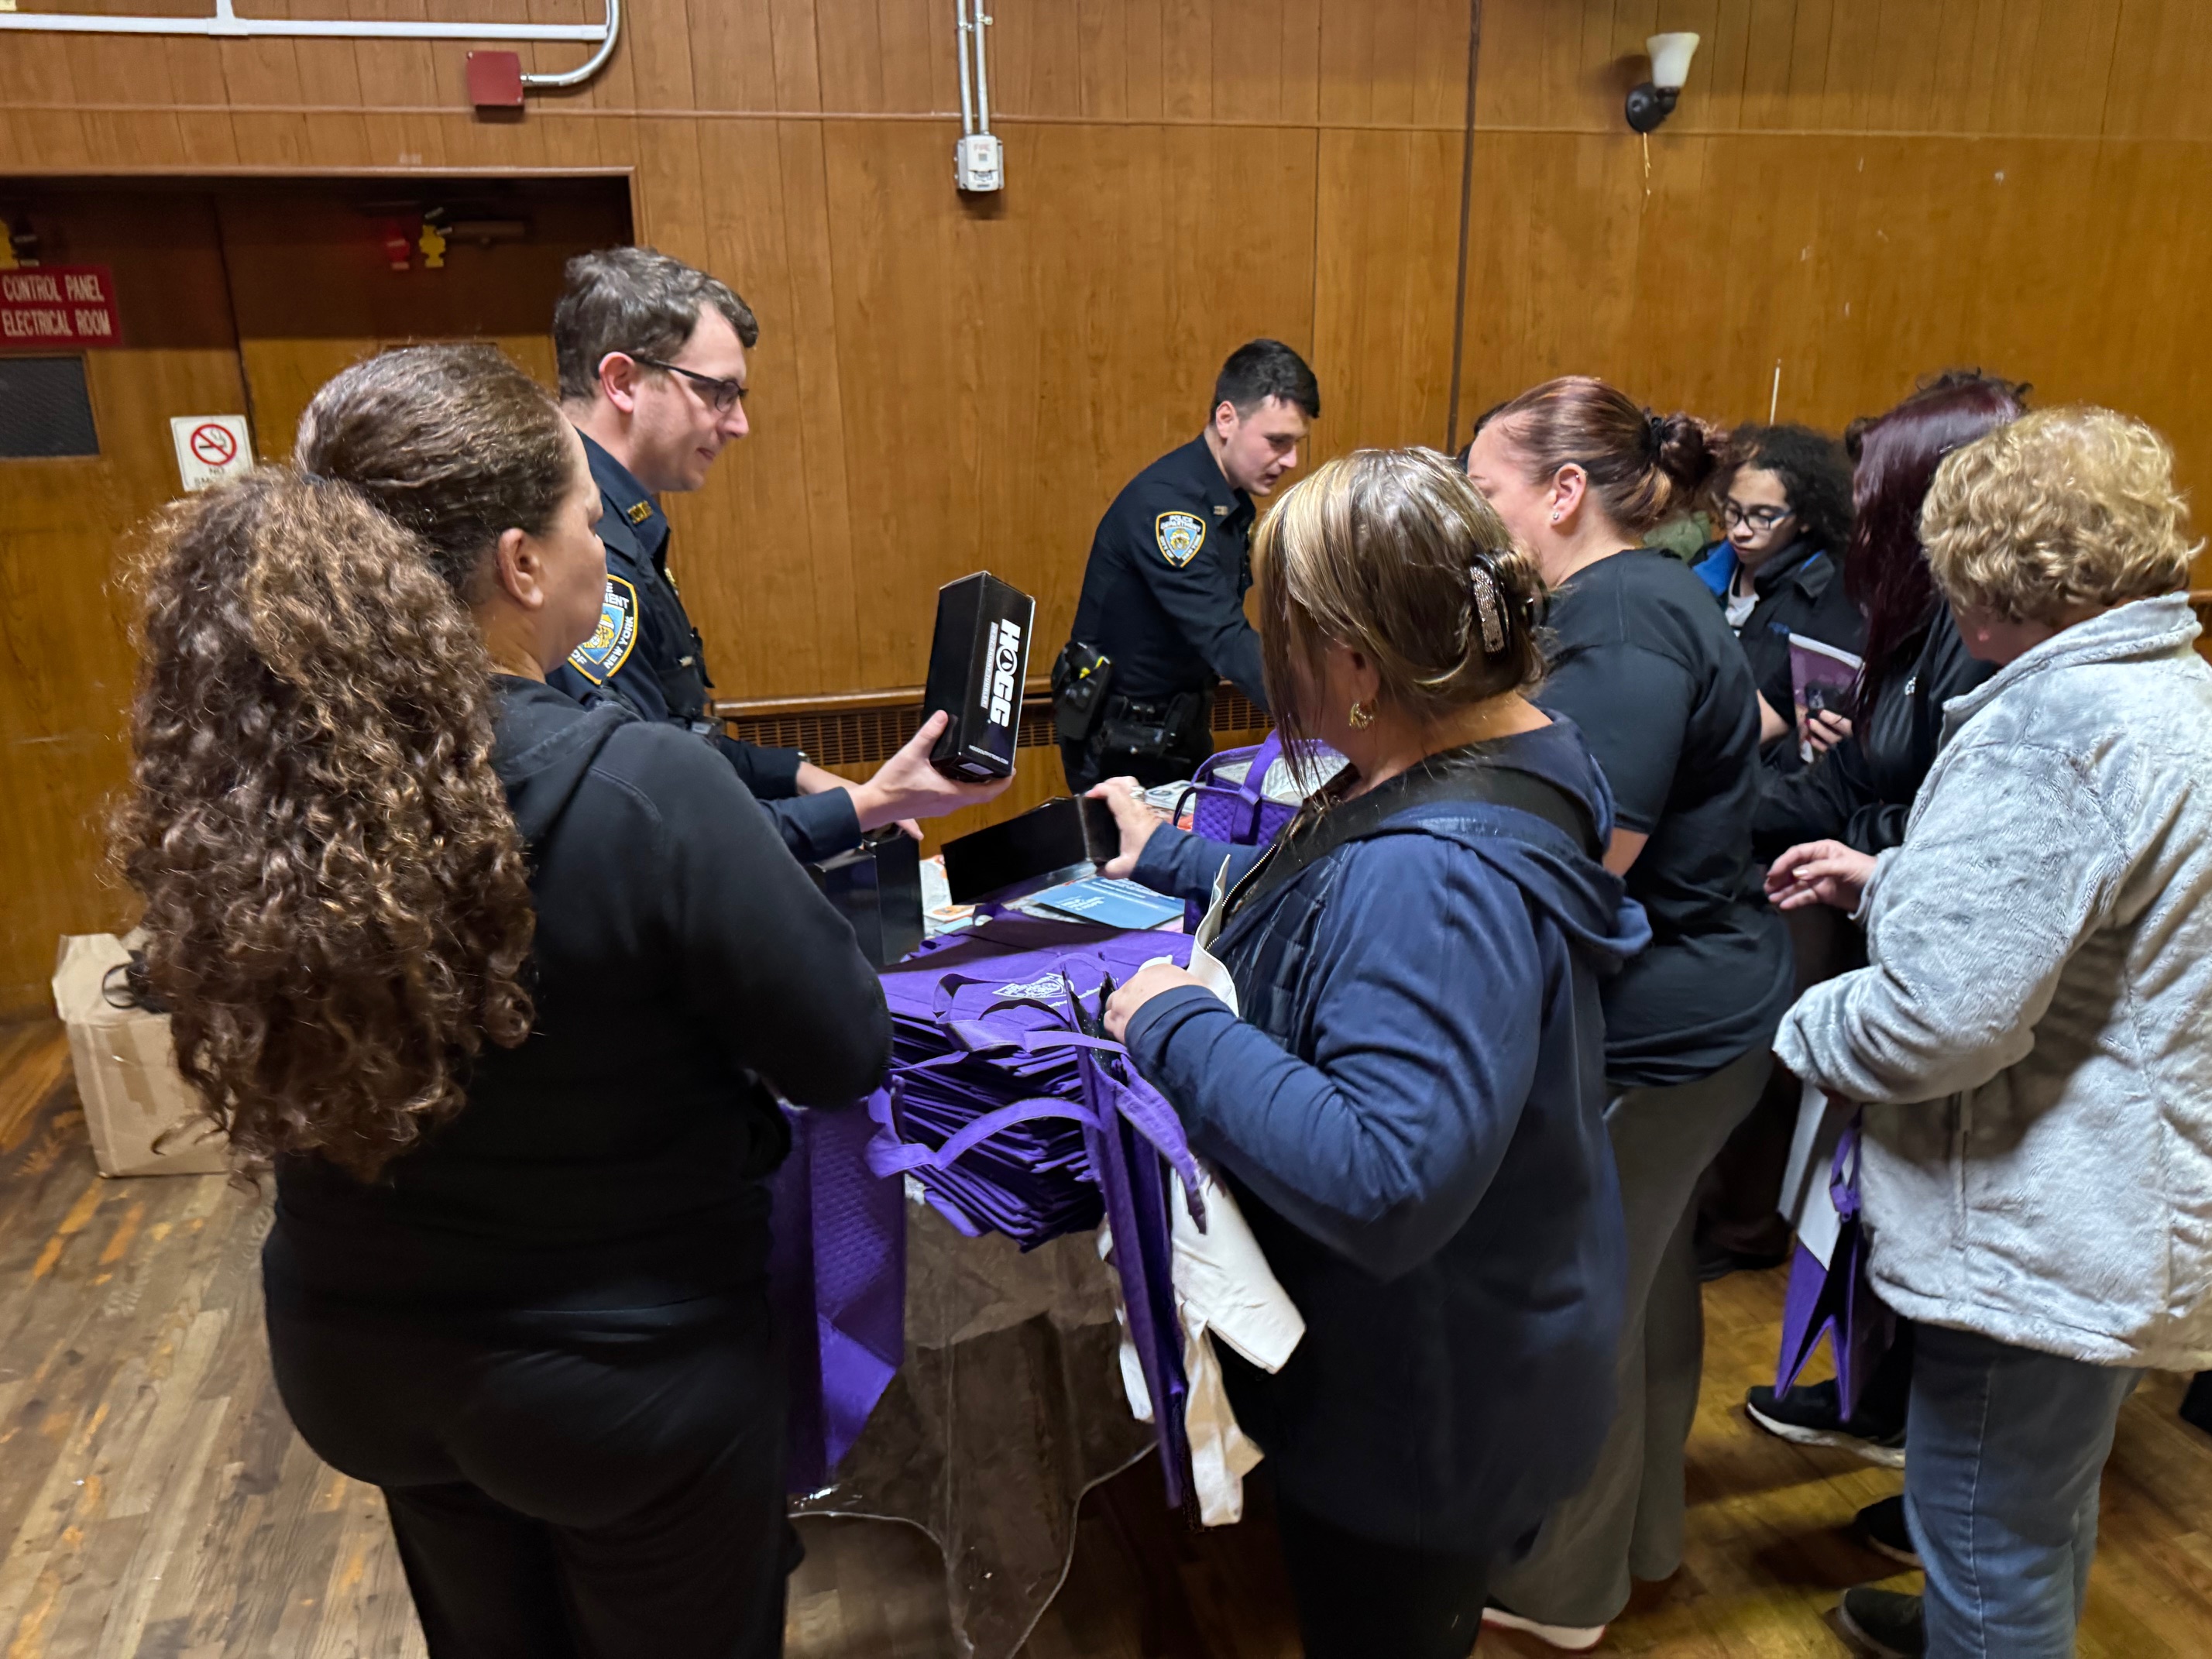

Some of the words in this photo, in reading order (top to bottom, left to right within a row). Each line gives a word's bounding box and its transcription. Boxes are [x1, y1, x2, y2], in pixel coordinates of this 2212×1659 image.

[2, 274, 62, 302] CONTROL
[64, 274, 105, 303] PANEL
[2, 309, 73, 337] ELECTRICAL
[75, 309, 112, 336] ROOM
[1169, 514, 1194, 524] POLICE
[603, 645, 623, 669] NEW
[618, 616, 634, 646] YORK
[571, 649, 588, 665] OF
[985, 647, 995, 672] SKINNY
[990, 618, 1021, 727] HOGG
[981, 674, 991, 706] TUMBLER
